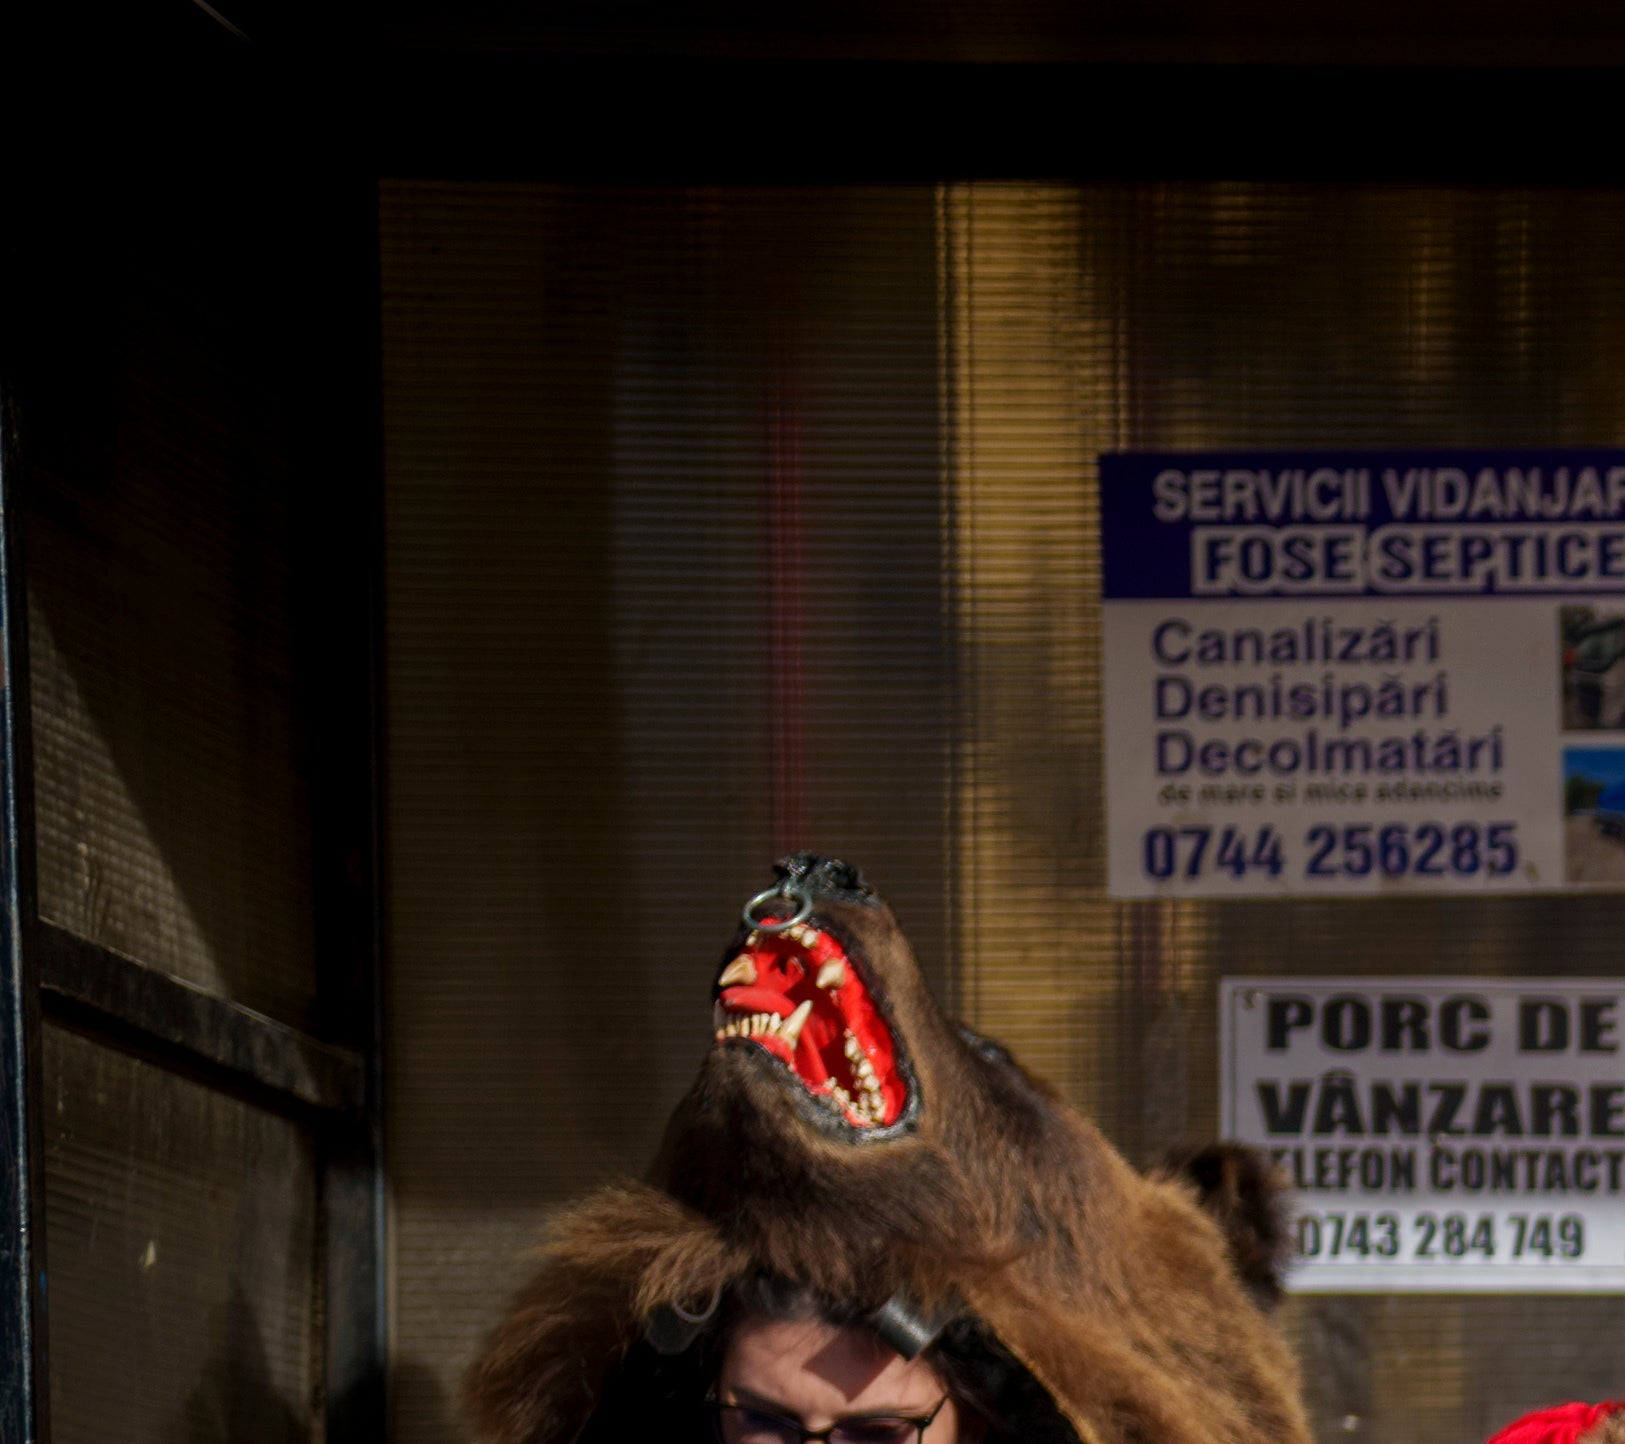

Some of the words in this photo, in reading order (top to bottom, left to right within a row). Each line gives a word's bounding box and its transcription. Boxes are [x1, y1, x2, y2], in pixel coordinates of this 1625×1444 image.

[1152, 468, 1370, 522] SERVICII
[1200, 530, 1357, 584] FOSE
[1152, 616, 1441, 667] Canalizări
[1154, 672, 1450, 729] Denisipări
[1154, 727, 1505, 777] Decolmatări
[1142, 825, 1284, 882] 0744
[1304, 820, 1518, 879] 256285
[1265, 992, 1495, 1053] PORC
[1517, 994, 1621, 1054] DE
[1270, 1146, 1417, 1193] LEFON
[1298, 1212, 1402, 1259] 0743
[1413, 1212, 1497, 1260] 284
[1508, 1212, 1588, 1260] 749
